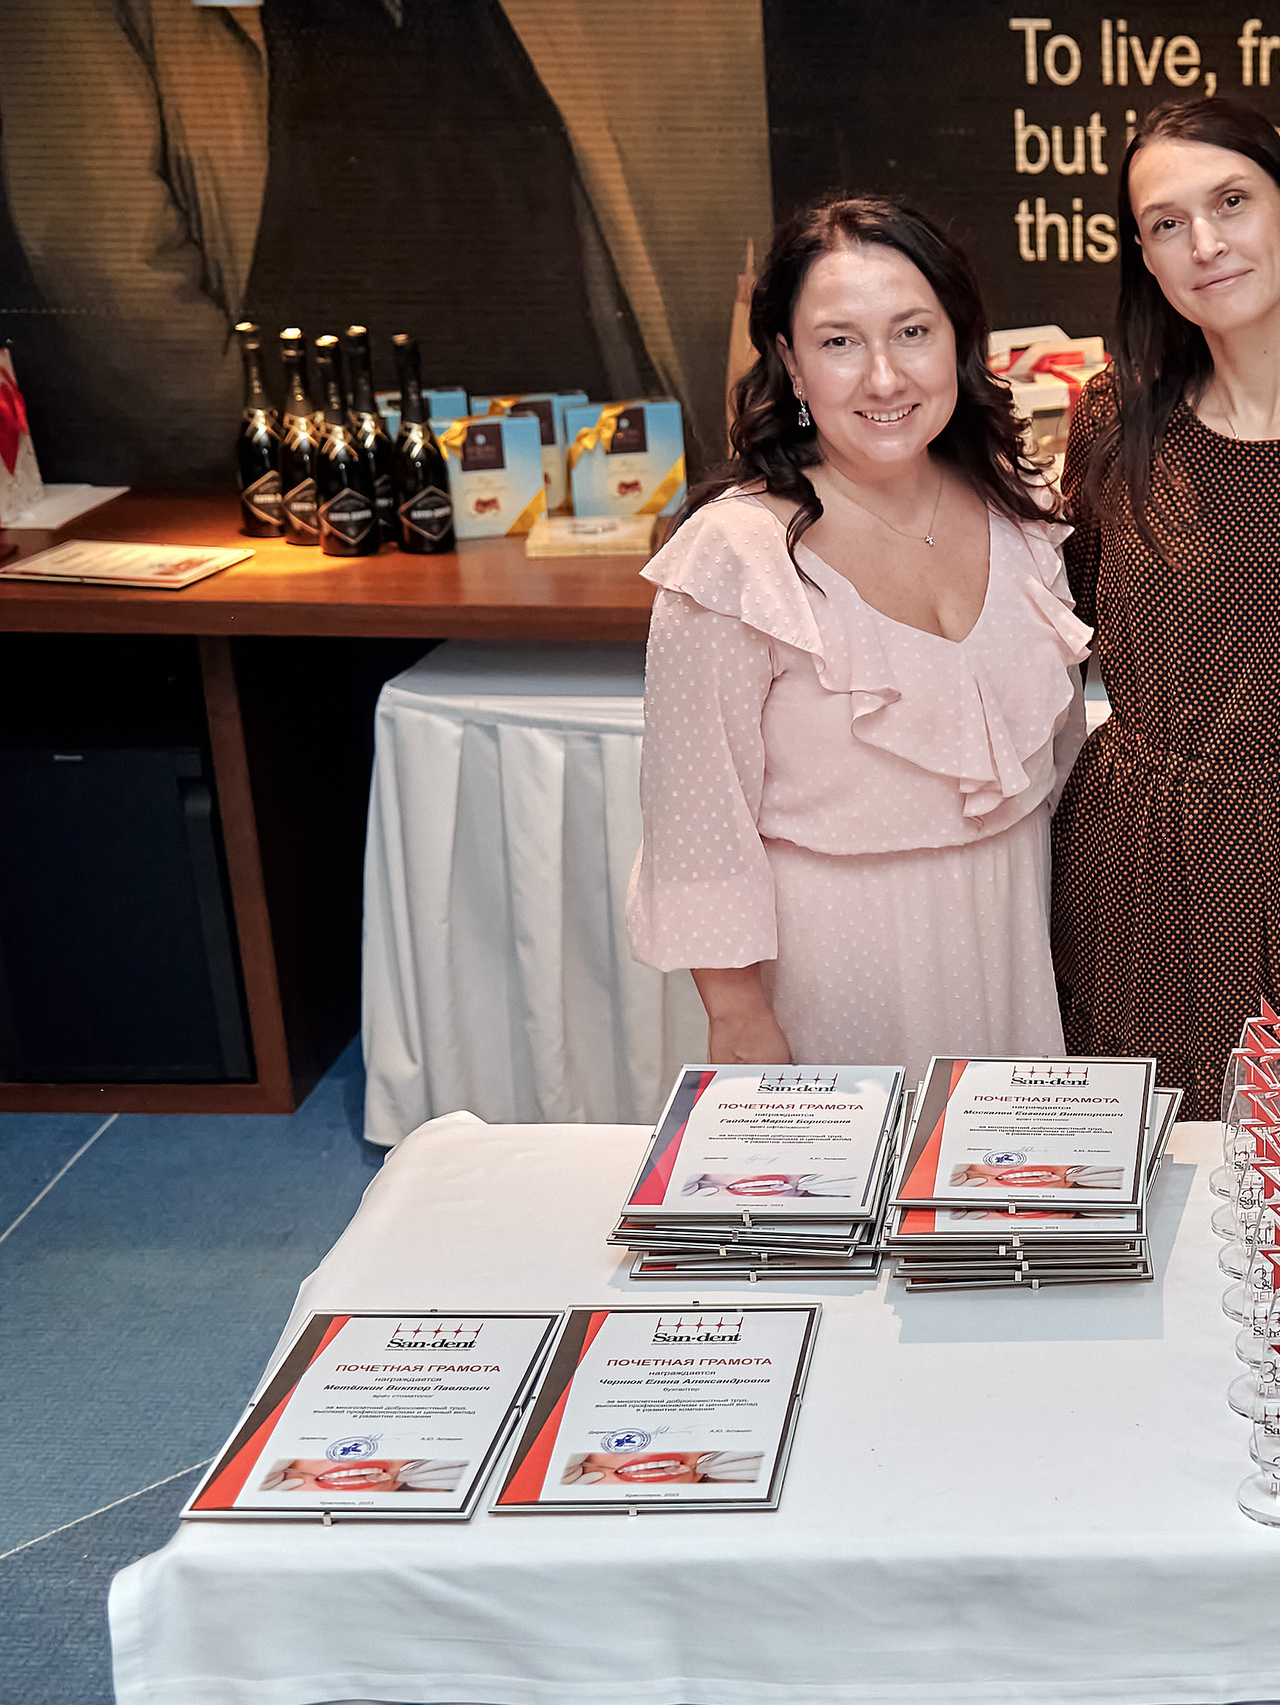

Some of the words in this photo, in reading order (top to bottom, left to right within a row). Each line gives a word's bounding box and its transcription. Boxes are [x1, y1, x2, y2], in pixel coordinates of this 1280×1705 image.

[1009, 18, 1082, 86] To
[1102, 18, 1218, 97] live,
[1013, 108, 1109, 175] but
[1014, 197, 1119, 263] this
[973, 1095, 1050, 1103] ПОЧЕТНАЯ
[1055, 1096, 1120, 1104] ГРАМОТА
[607, 1358, 694, 1366] ПОЧЕТНАЯ
[699, 1357, 773, 1366] ГРАМОТА
[335, 1364, 424, 1372] ПОЧЕТНАЯ
[428, 1364, 501, 1372] ГРАМОТА
[682, 1377, 771, 1385] Александровна
[386, 1384, 432, 1392] Виктор
